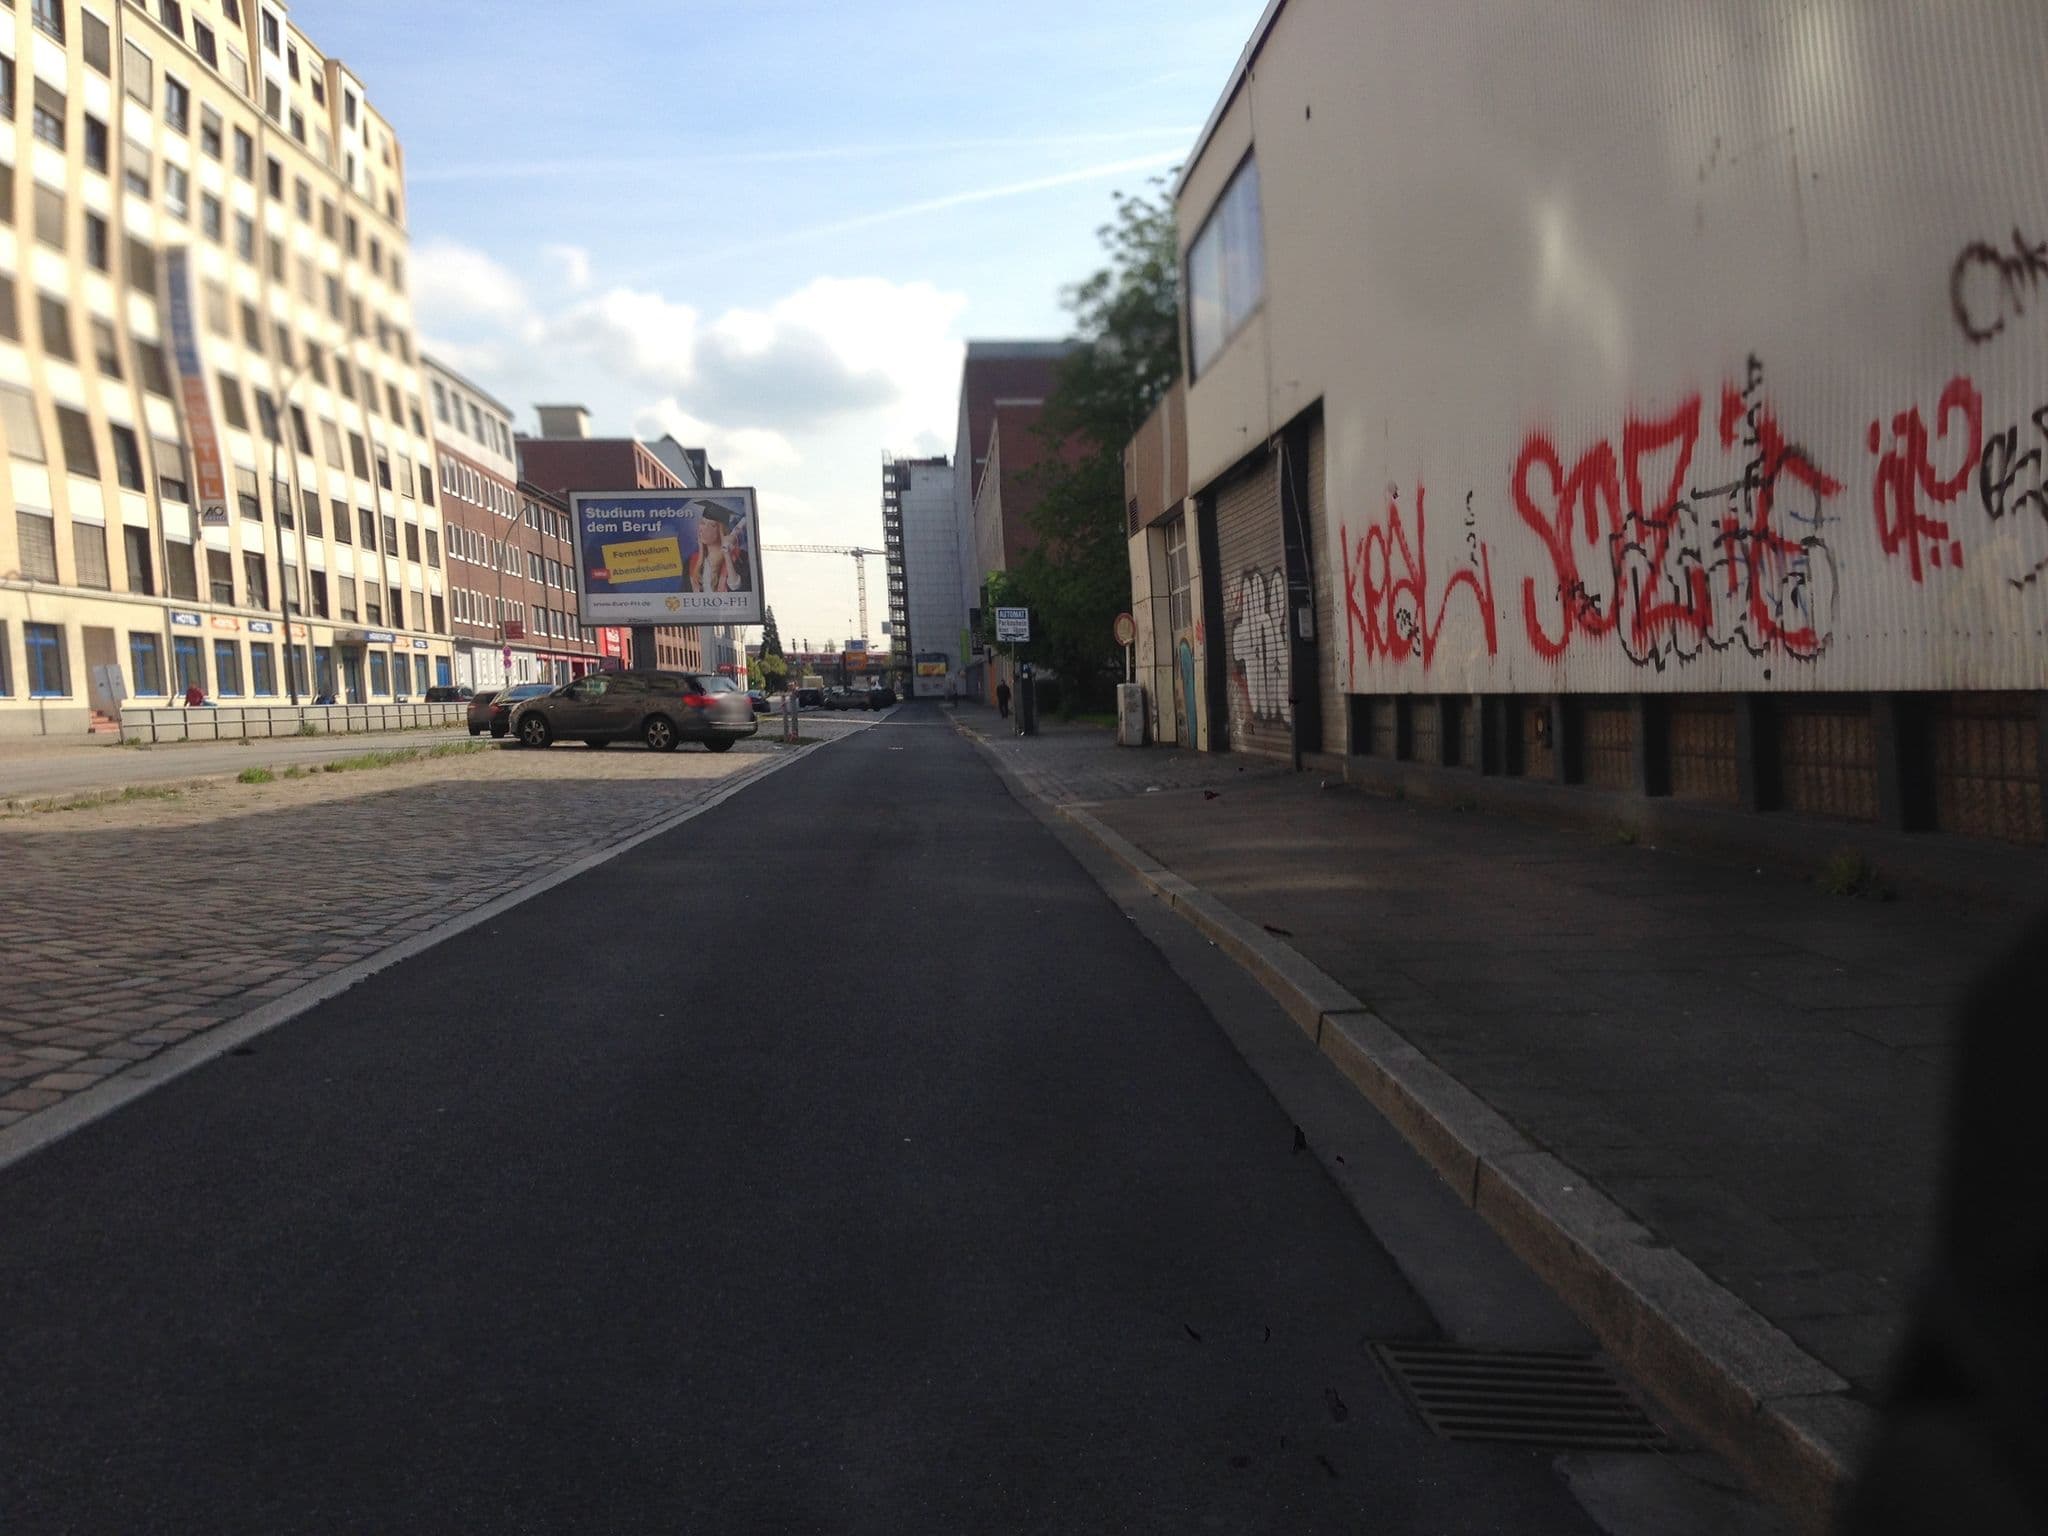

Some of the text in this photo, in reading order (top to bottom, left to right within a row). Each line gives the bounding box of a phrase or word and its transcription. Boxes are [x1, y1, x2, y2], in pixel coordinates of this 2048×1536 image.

[585, 505, 694, 519] Studium neben
[586, 520, 662, 534] dem Beruf
[612, 545, 670, 559] Fernstudium
[612, 562, 678, 577] Abendstudium
[683, 596, 748, 608] EURO-FH
